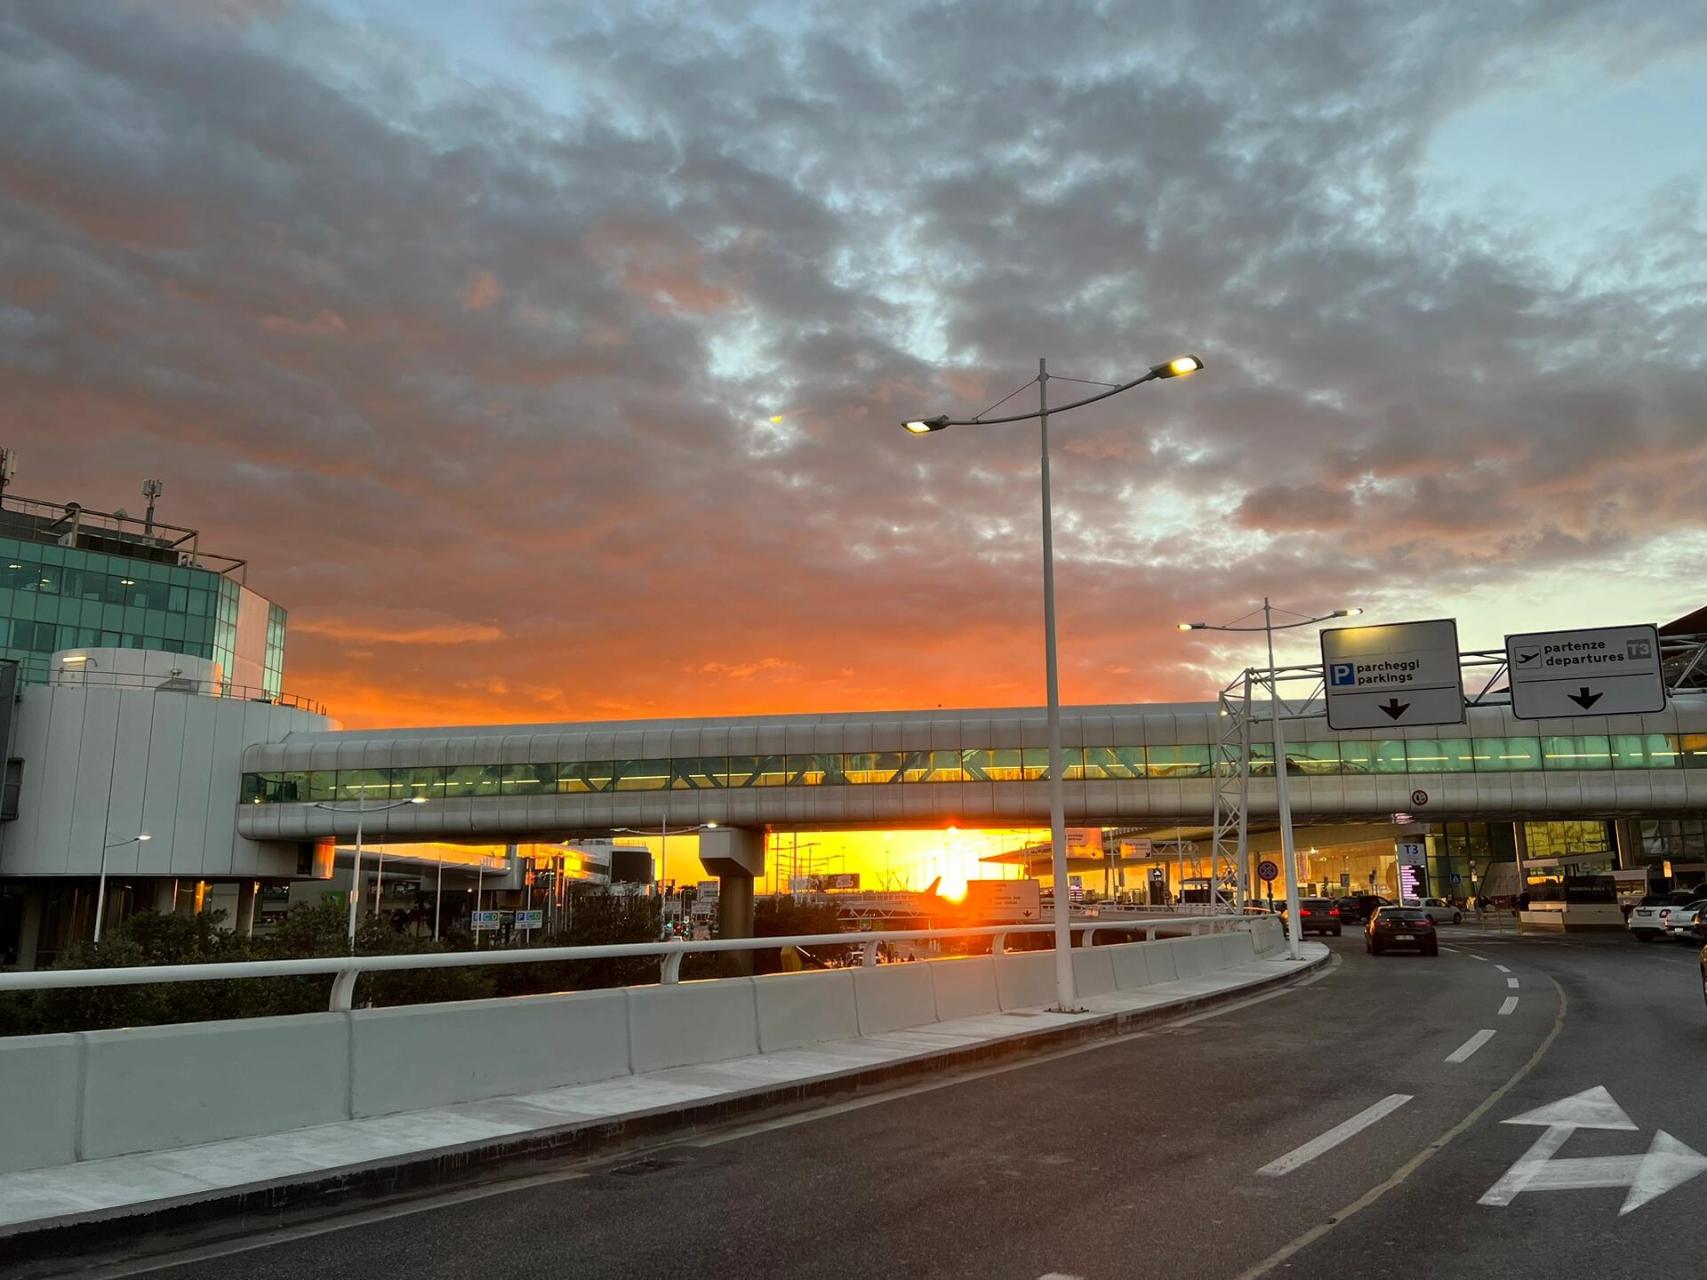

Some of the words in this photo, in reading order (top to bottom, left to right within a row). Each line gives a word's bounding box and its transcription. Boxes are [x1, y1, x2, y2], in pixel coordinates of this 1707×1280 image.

[1544, 641, 1606, 654] partenze
[1628, 643, 1650, 656] T3
[1357, 659, 1420, 674] parcheggi
[1546, 653, 1624, 667] departures
[1334, 665, 1350, 684] P
[1358, 673, 1413, 686] parkings
[1404, 844, 1419, 854] T3
